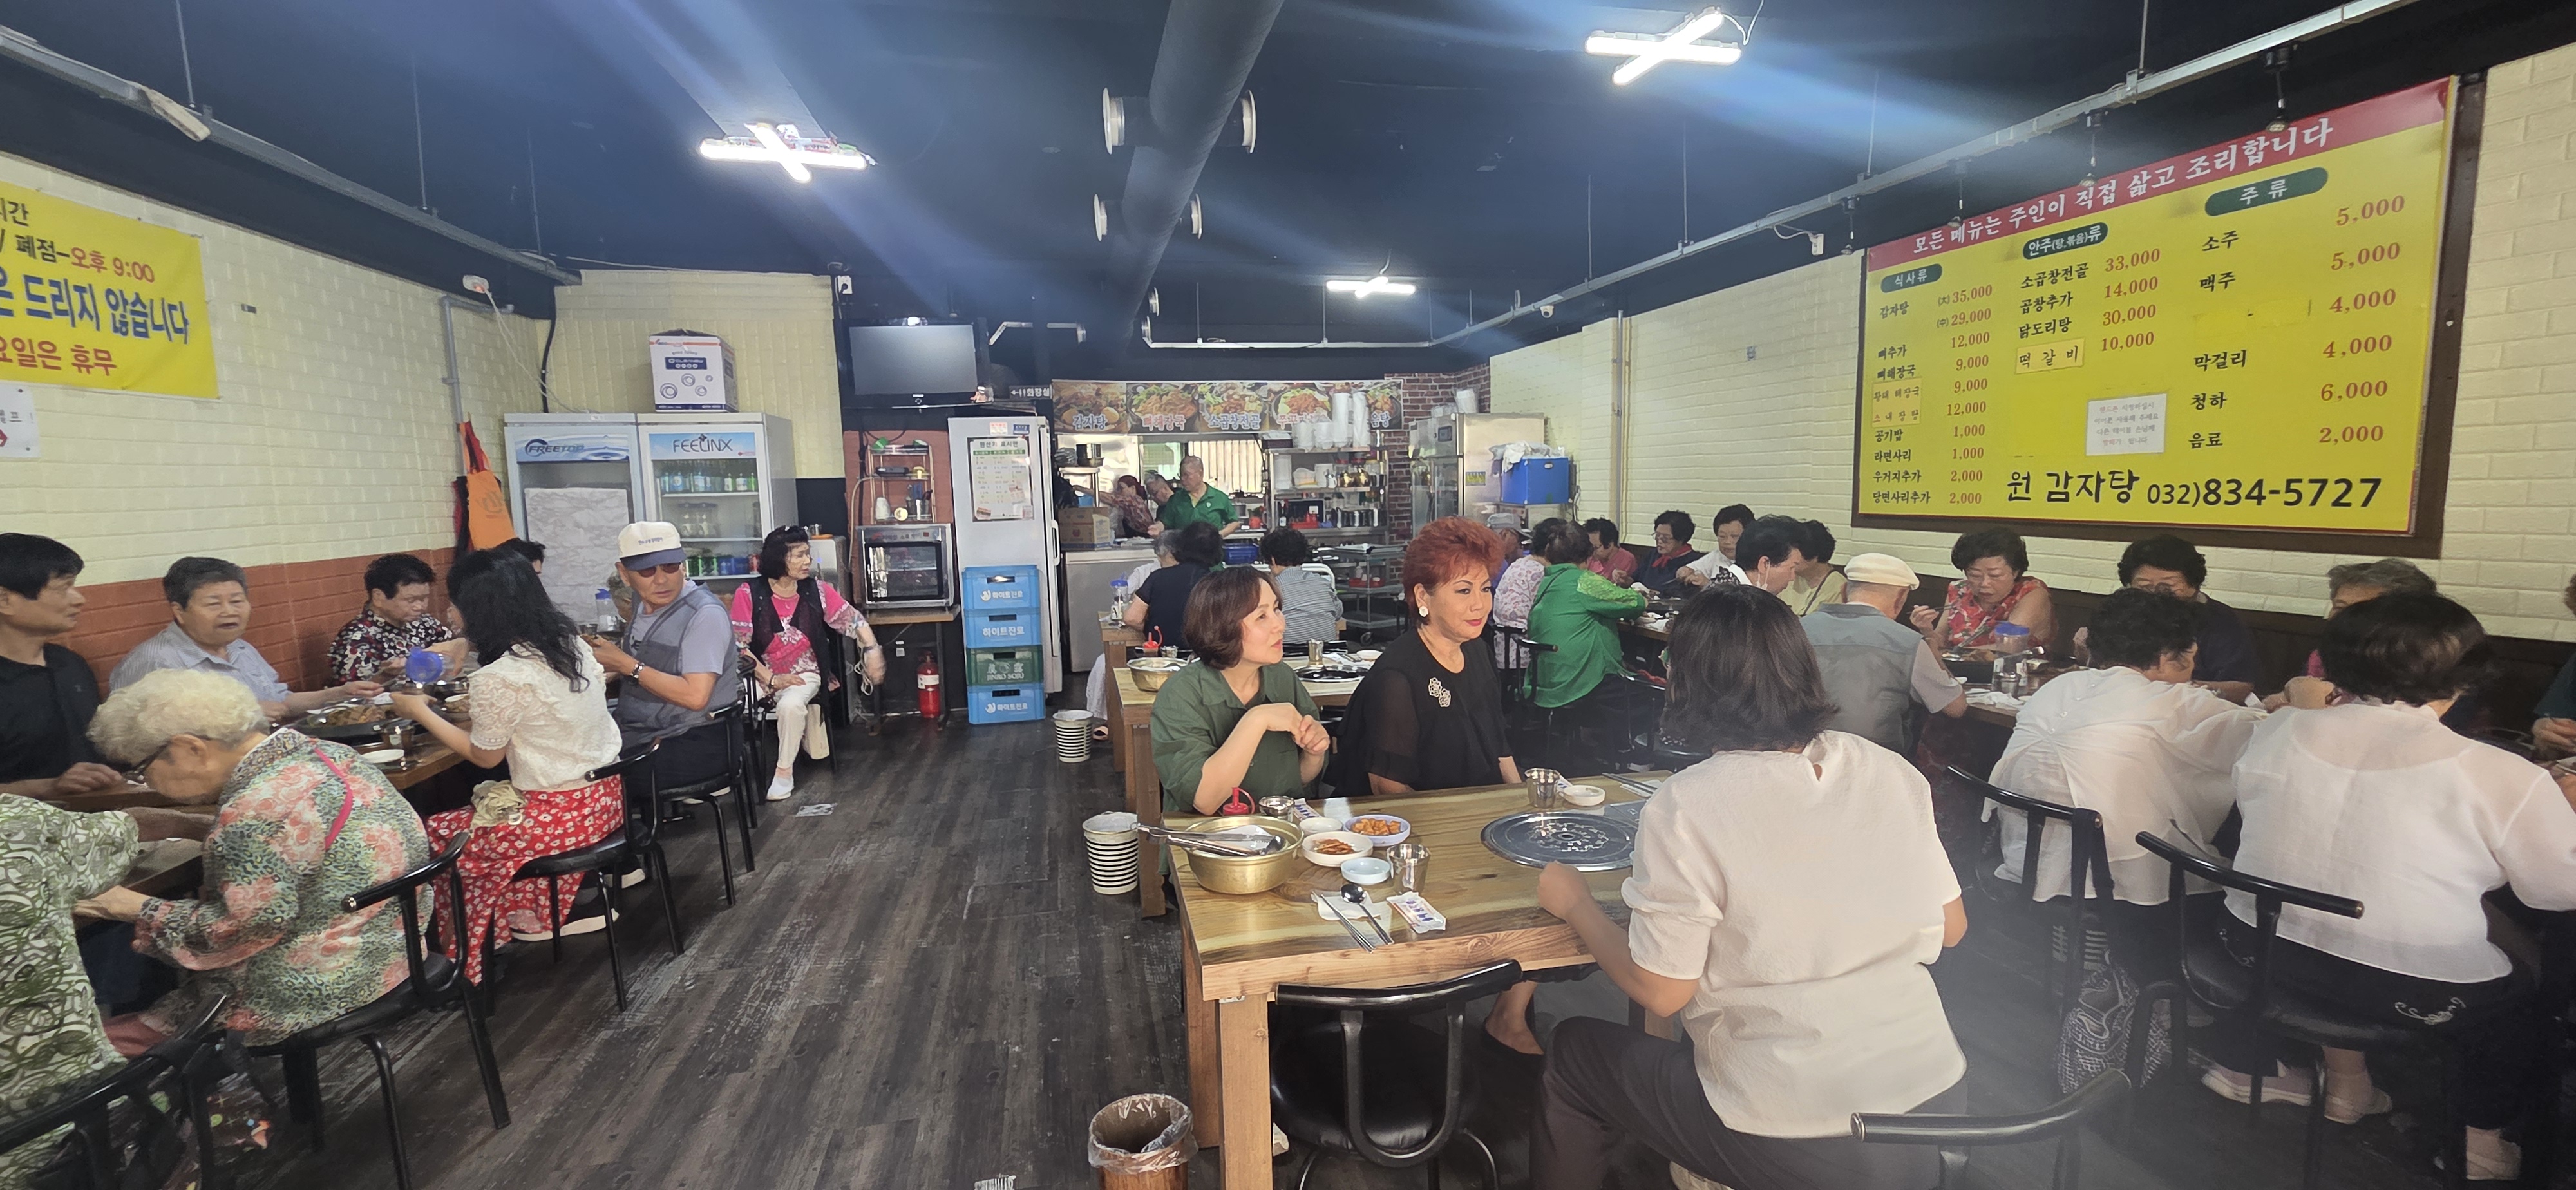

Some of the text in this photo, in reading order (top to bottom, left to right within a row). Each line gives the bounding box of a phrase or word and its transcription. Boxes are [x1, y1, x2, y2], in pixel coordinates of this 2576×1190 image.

[1913, 118, 2334, 254] 모든 메뉴는 주인이 직접 삶고 조리합니다
[2201, 195, 2405, 252] 소주 5,000
[113, 257, 155, 283] 9:00
[2020, 248, 2161, 289] 소곱창전골 33,000
[2199, 241, 2401, 293] 맥주 5,000
[1894, 269, 1928, 287] 식사류
[1880, 301, 1909, 319] 감자탕
[1952, 284, 1993, 303] 35,000
[2020, 276, 2159, 315] 곱창추가 14,000
[2329, 288, 2397, 314] 4,000
[23, 274, 100, 332] 드리지
[104, 287, 191, 345] 않습니다
[1951, 308, 1992, 326] 29,000
[2018, 304, 2157, 339] 닭도리탕 30,000
[1951, 331, 1990, 349] 12,000
[2101, 331, 2155, 352] 10,000
[70, 344, 118, 377] 휴무
[1956, 355, 1989, 371] 9,000
[2193, 334, 2392, 372] 막걸리 4,000
[1954, 378, 1988, 394] 9,000
[2191, 380, 2389, 411] 청하 6,000
[1946, 401, 1987, 417] 12,000
[1072, 413, 1107, 431] 감자탕
[1209, 413, 1261, 431] 소곱창전골
[1875, 424, 1985, 443] 공기밥 1,000
[2188, 424, 2384, 449] 음료 2,000
[672, 437, 734, 453] FEELINX
[1873, 446, 1984, 462] 라면사리 1,000
[1873, 469, 1983, 483] 우거지추가 2,000
[2007, 471, 2032, 502] 원
[2045, 469, 2140, 504] 감자탕
[1872, 490, 1982, 505] 당면사리추가 2,000
[992, 590, 1023, 599] 하이트진로
[982, 626, 1025, 637] 하이트진로
[997, 702, 1028, 711] 하이트진로
